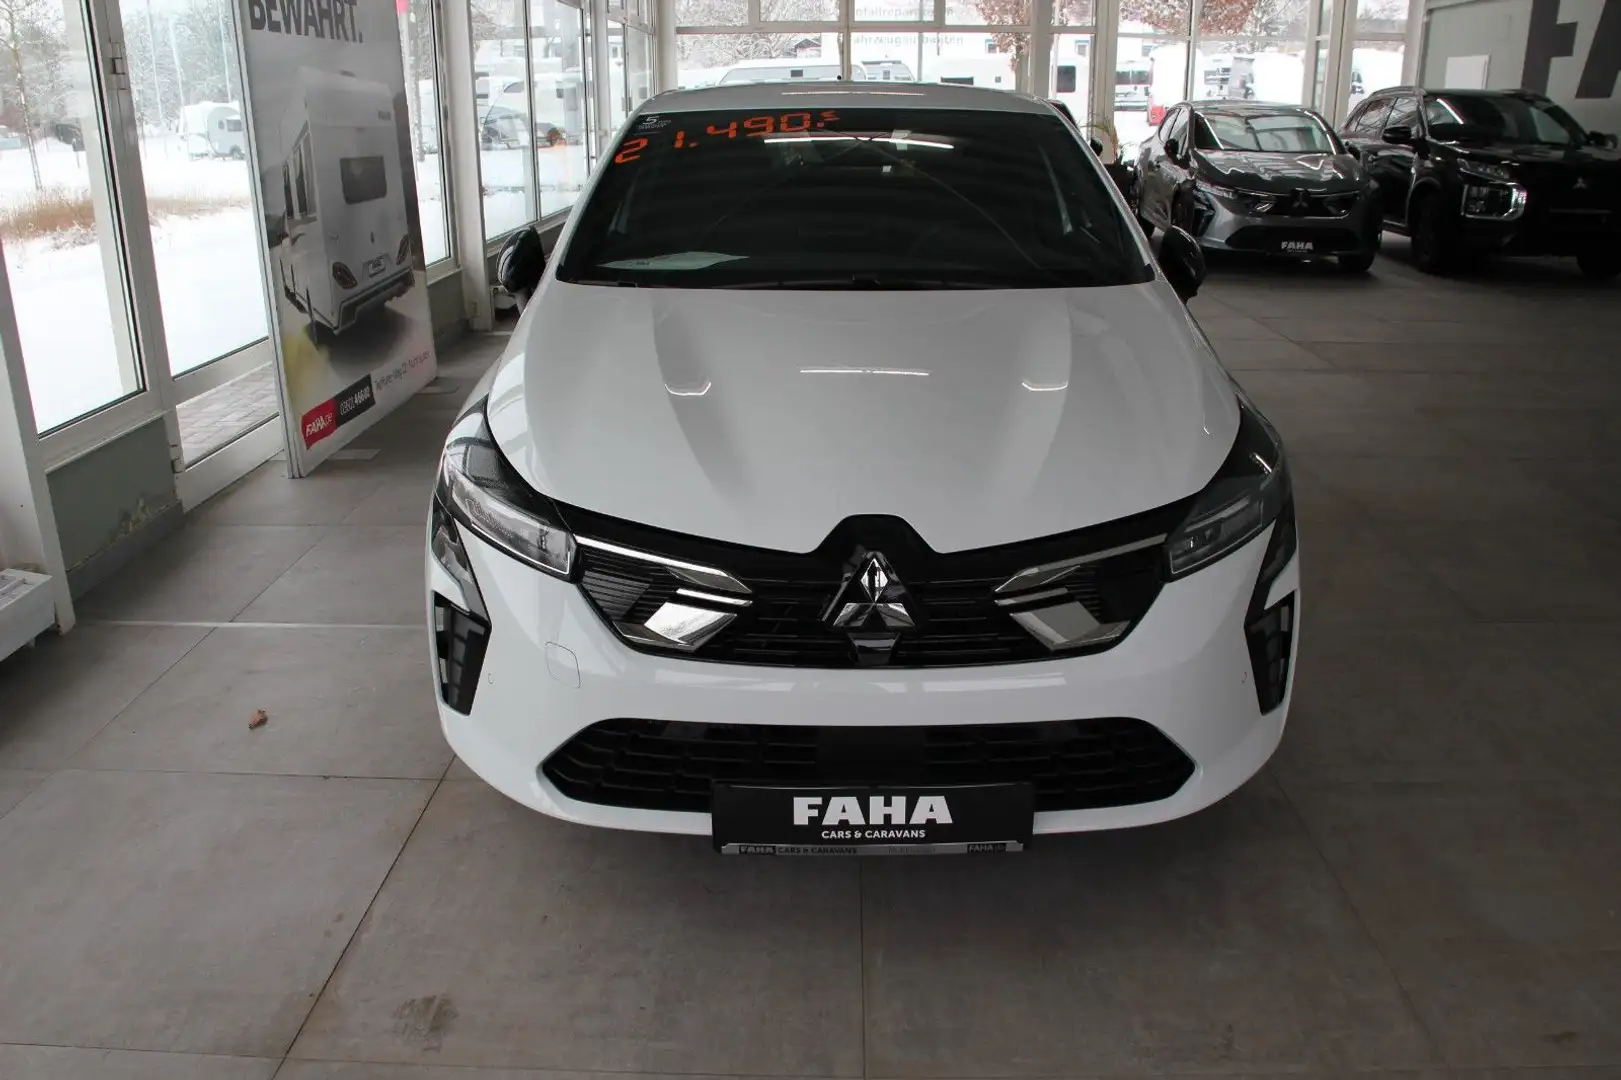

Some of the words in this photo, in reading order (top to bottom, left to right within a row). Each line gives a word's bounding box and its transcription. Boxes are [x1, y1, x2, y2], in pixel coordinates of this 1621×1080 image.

[1281, 240, 1313, 250] FAHA
[793, 796, 953, 825] FAHA
[821, 830, 852, 839] CARS
[854, 831, 863, 839] &
[864, 829, 926, 839] CARAVANS
[777, 846, 801, 854] CARS
